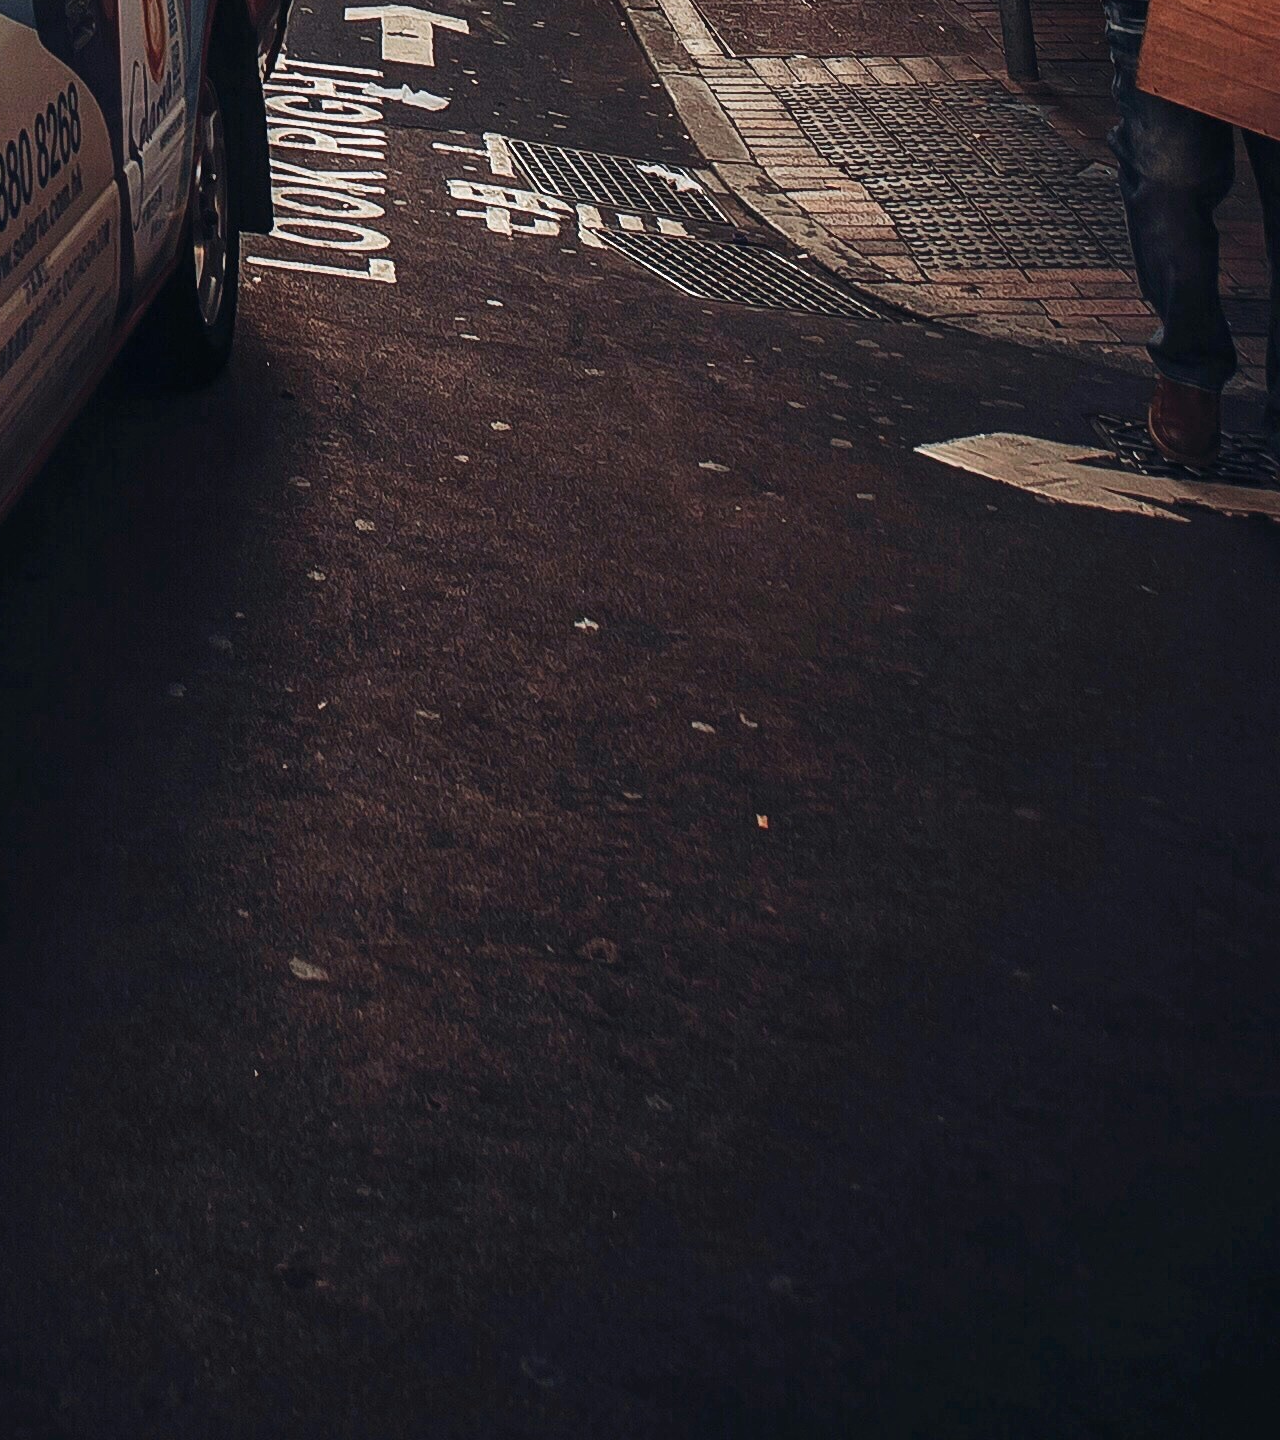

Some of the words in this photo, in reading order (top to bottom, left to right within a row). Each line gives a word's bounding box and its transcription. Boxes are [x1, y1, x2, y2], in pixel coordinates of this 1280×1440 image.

[34, 81, 82, 190] 8268
[263, 52, 388, 160] RIGHT
[245, 158, 397, 283] LOOK
